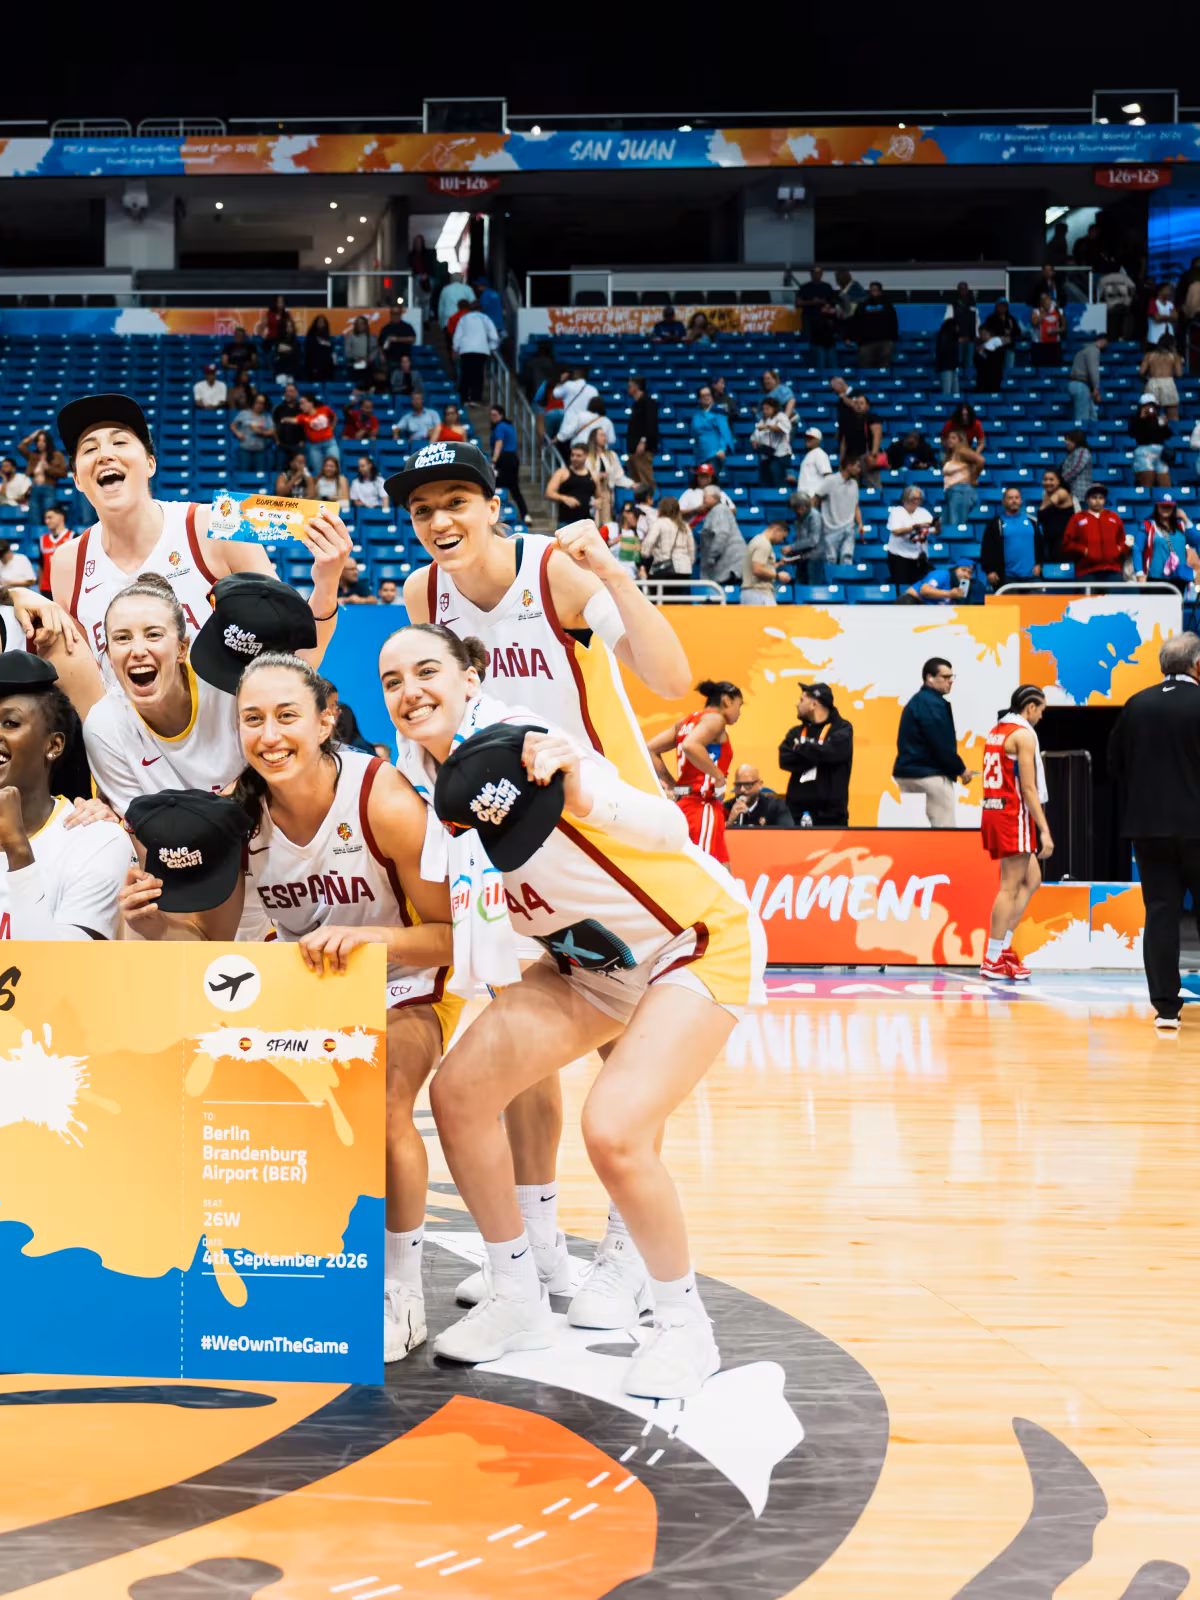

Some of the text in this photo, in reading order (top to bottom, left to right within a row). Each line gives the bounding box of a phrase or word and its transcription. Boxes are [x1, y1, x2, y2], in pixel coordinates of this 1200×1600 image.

[568, 138, 677, 161] SAN JUAN
[1108, 169, 1160, 184] 126-125
[484, 641, 554, 680] AÑA
[983, 751, 1003, 789] 23
[158, 846, 189, 859] #We
[256, 869, 376, 909] ESPAÑA
[733, 872, 952, 923] NAMENT
[503, 881, 556, 921] 44
[266, 1038, 309, 1052] SPAIN
[202, 1125, 250, 1141] Berlin
[202, 1144, 308, 1166] Brandenburg
[201, 1164, 308, 1184] Airport (BER)
[202, 1211, 242, 1227] 26W
[202, 1249, 369, 1270] 4th September 2026
[200, 1334, 350, 1354] #WeOwnTheGame
